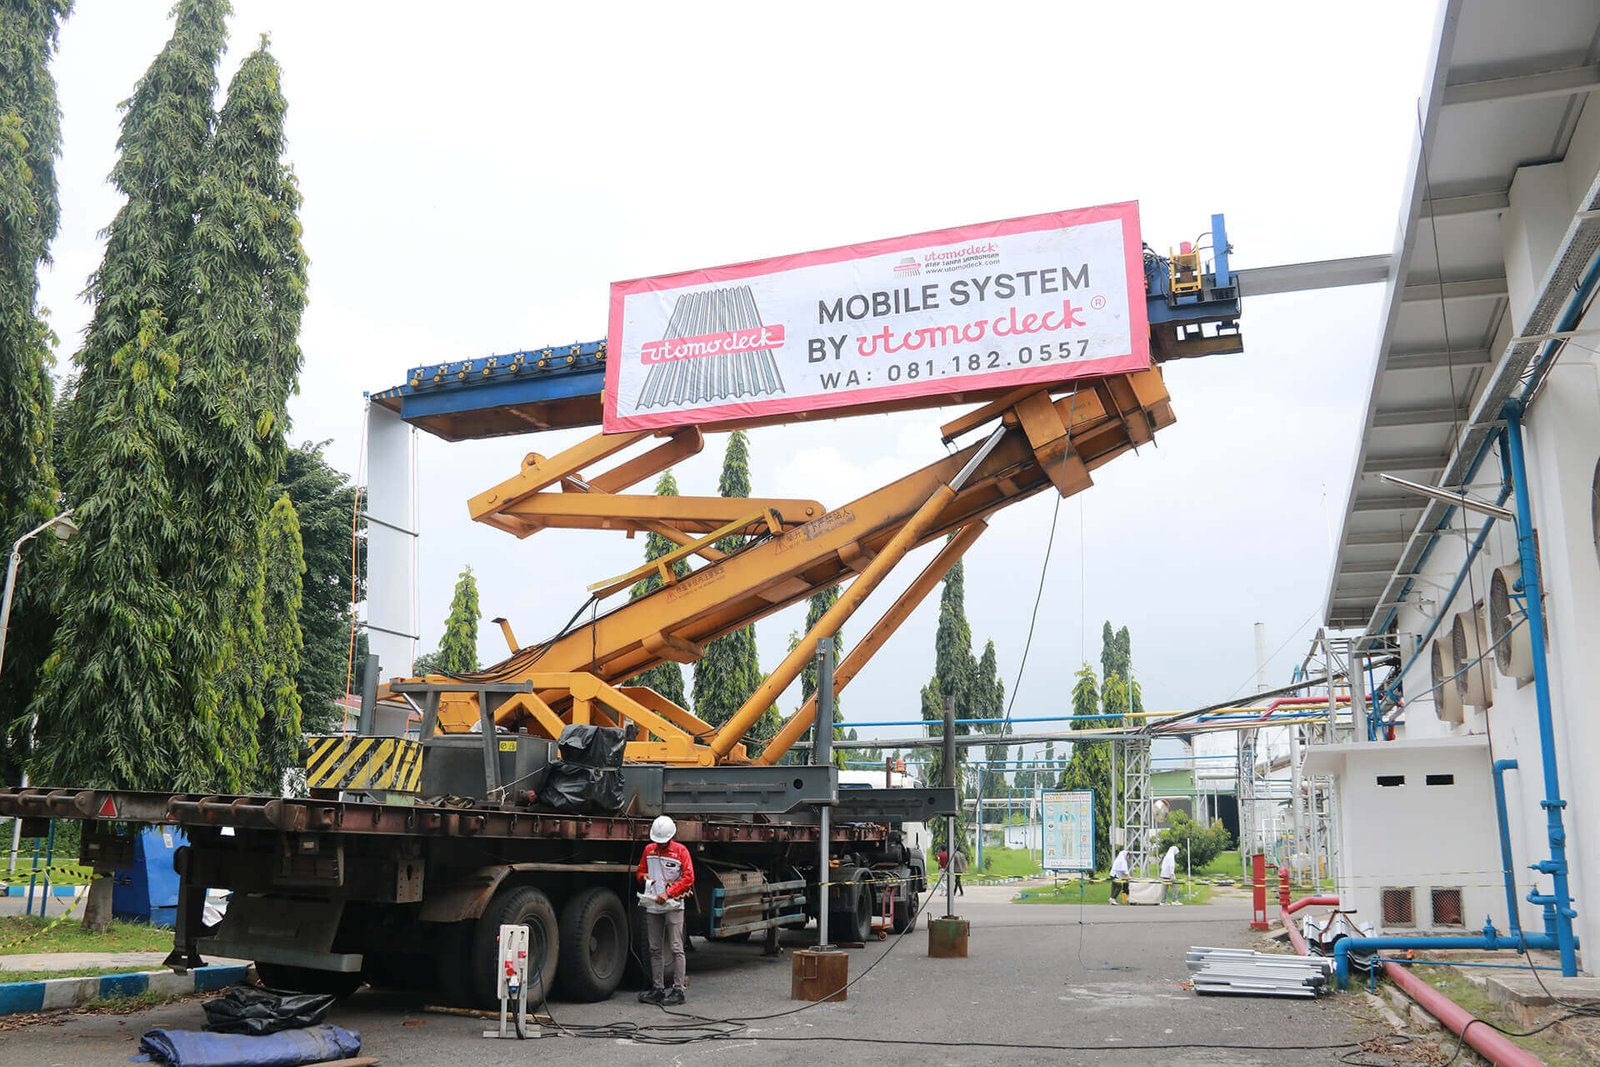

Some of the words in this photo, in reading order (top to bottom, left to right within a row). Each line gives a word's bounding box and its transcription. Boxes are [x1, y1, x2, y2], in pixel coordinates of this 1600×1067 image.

[925, 259, 1000, 275] www.utomodeck.com
[819, 283, 940, 325] MOBILE
[949, 263, 1090, 306] SYSTEM
[808, 334, 848, 363] BY
[887, 339, 1089, 381] 081.182.0557
